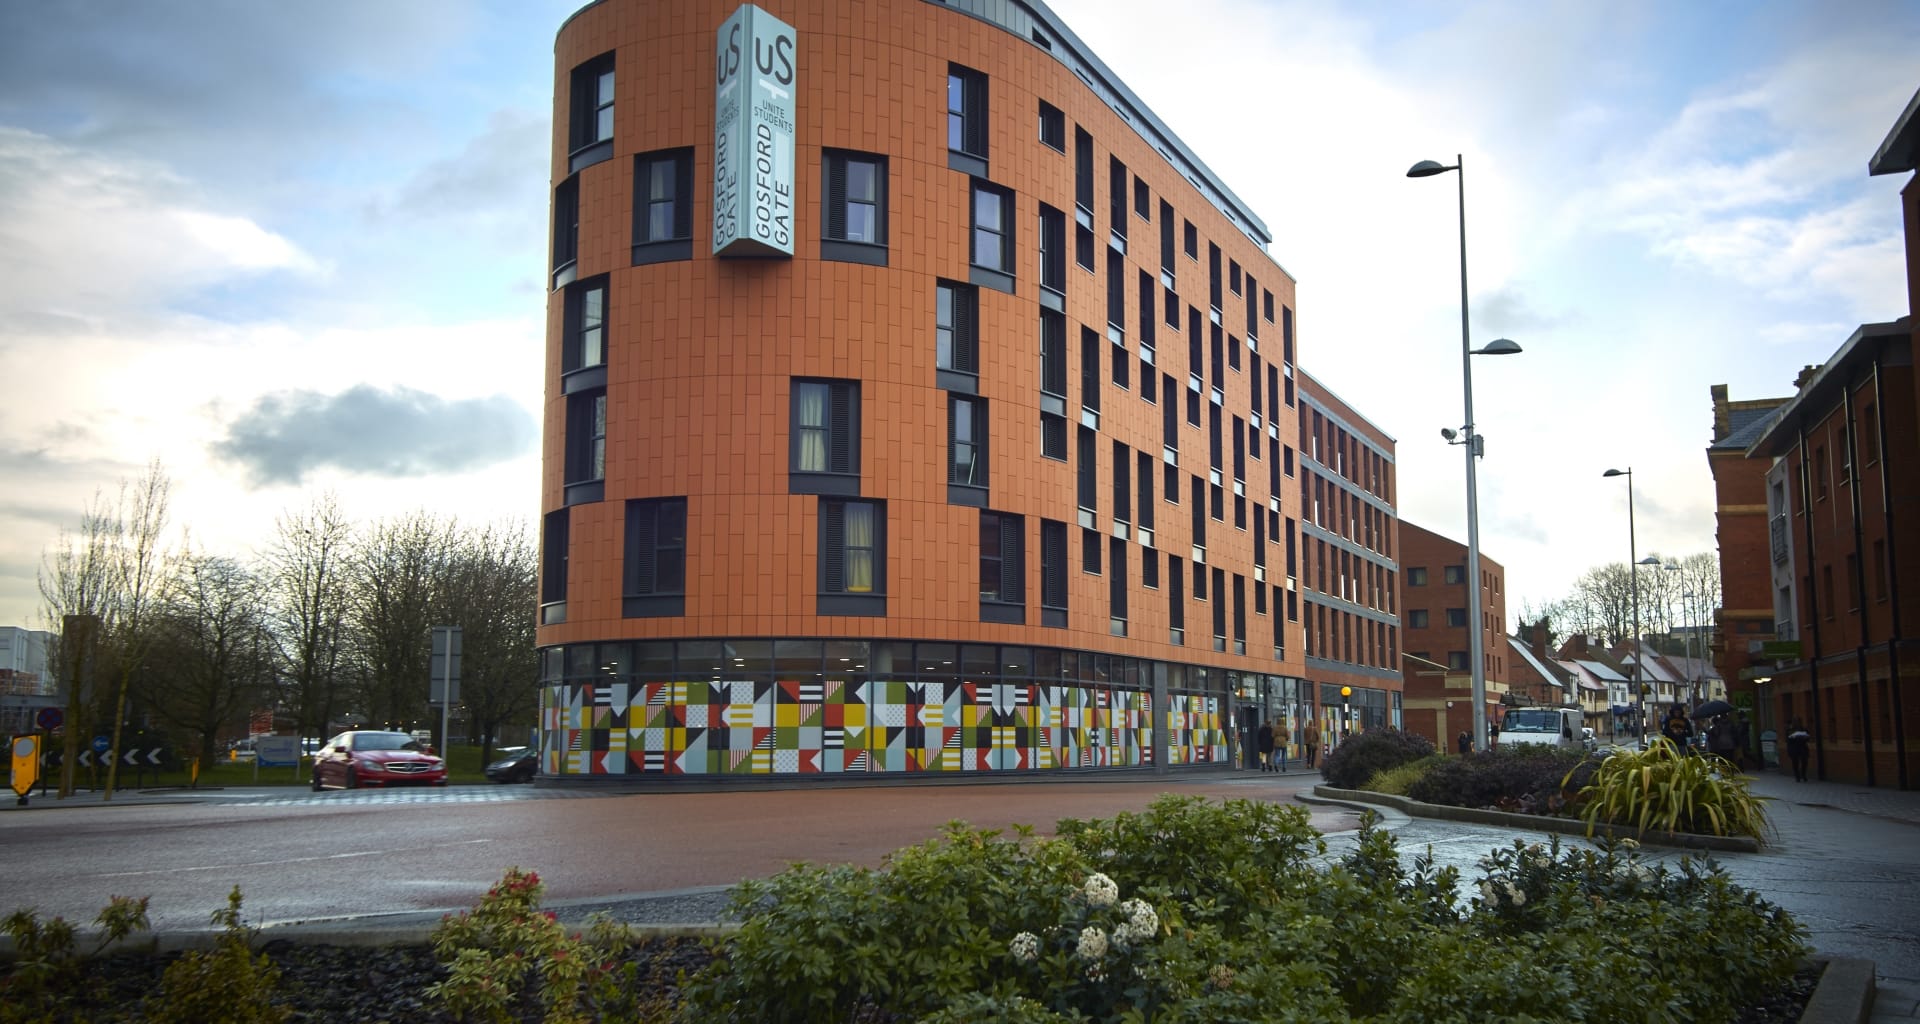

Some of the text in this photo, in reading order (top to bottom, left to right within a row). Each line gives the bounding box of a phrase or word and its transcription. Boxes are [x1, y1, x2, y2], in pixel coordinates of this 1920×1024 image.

[718, 22, 740, 86] US
[755, 34, 793, 86] US
[754, 106, 793, 133] STUDENTS
[762, 99, 785, 119] UNITE
[716, 132, 727, 247] GOSFORD
[726, 171, 737, 239] GATE
[756, 123, 772, 240] GOSFORD
[775, 180, 789, 247] GATE
